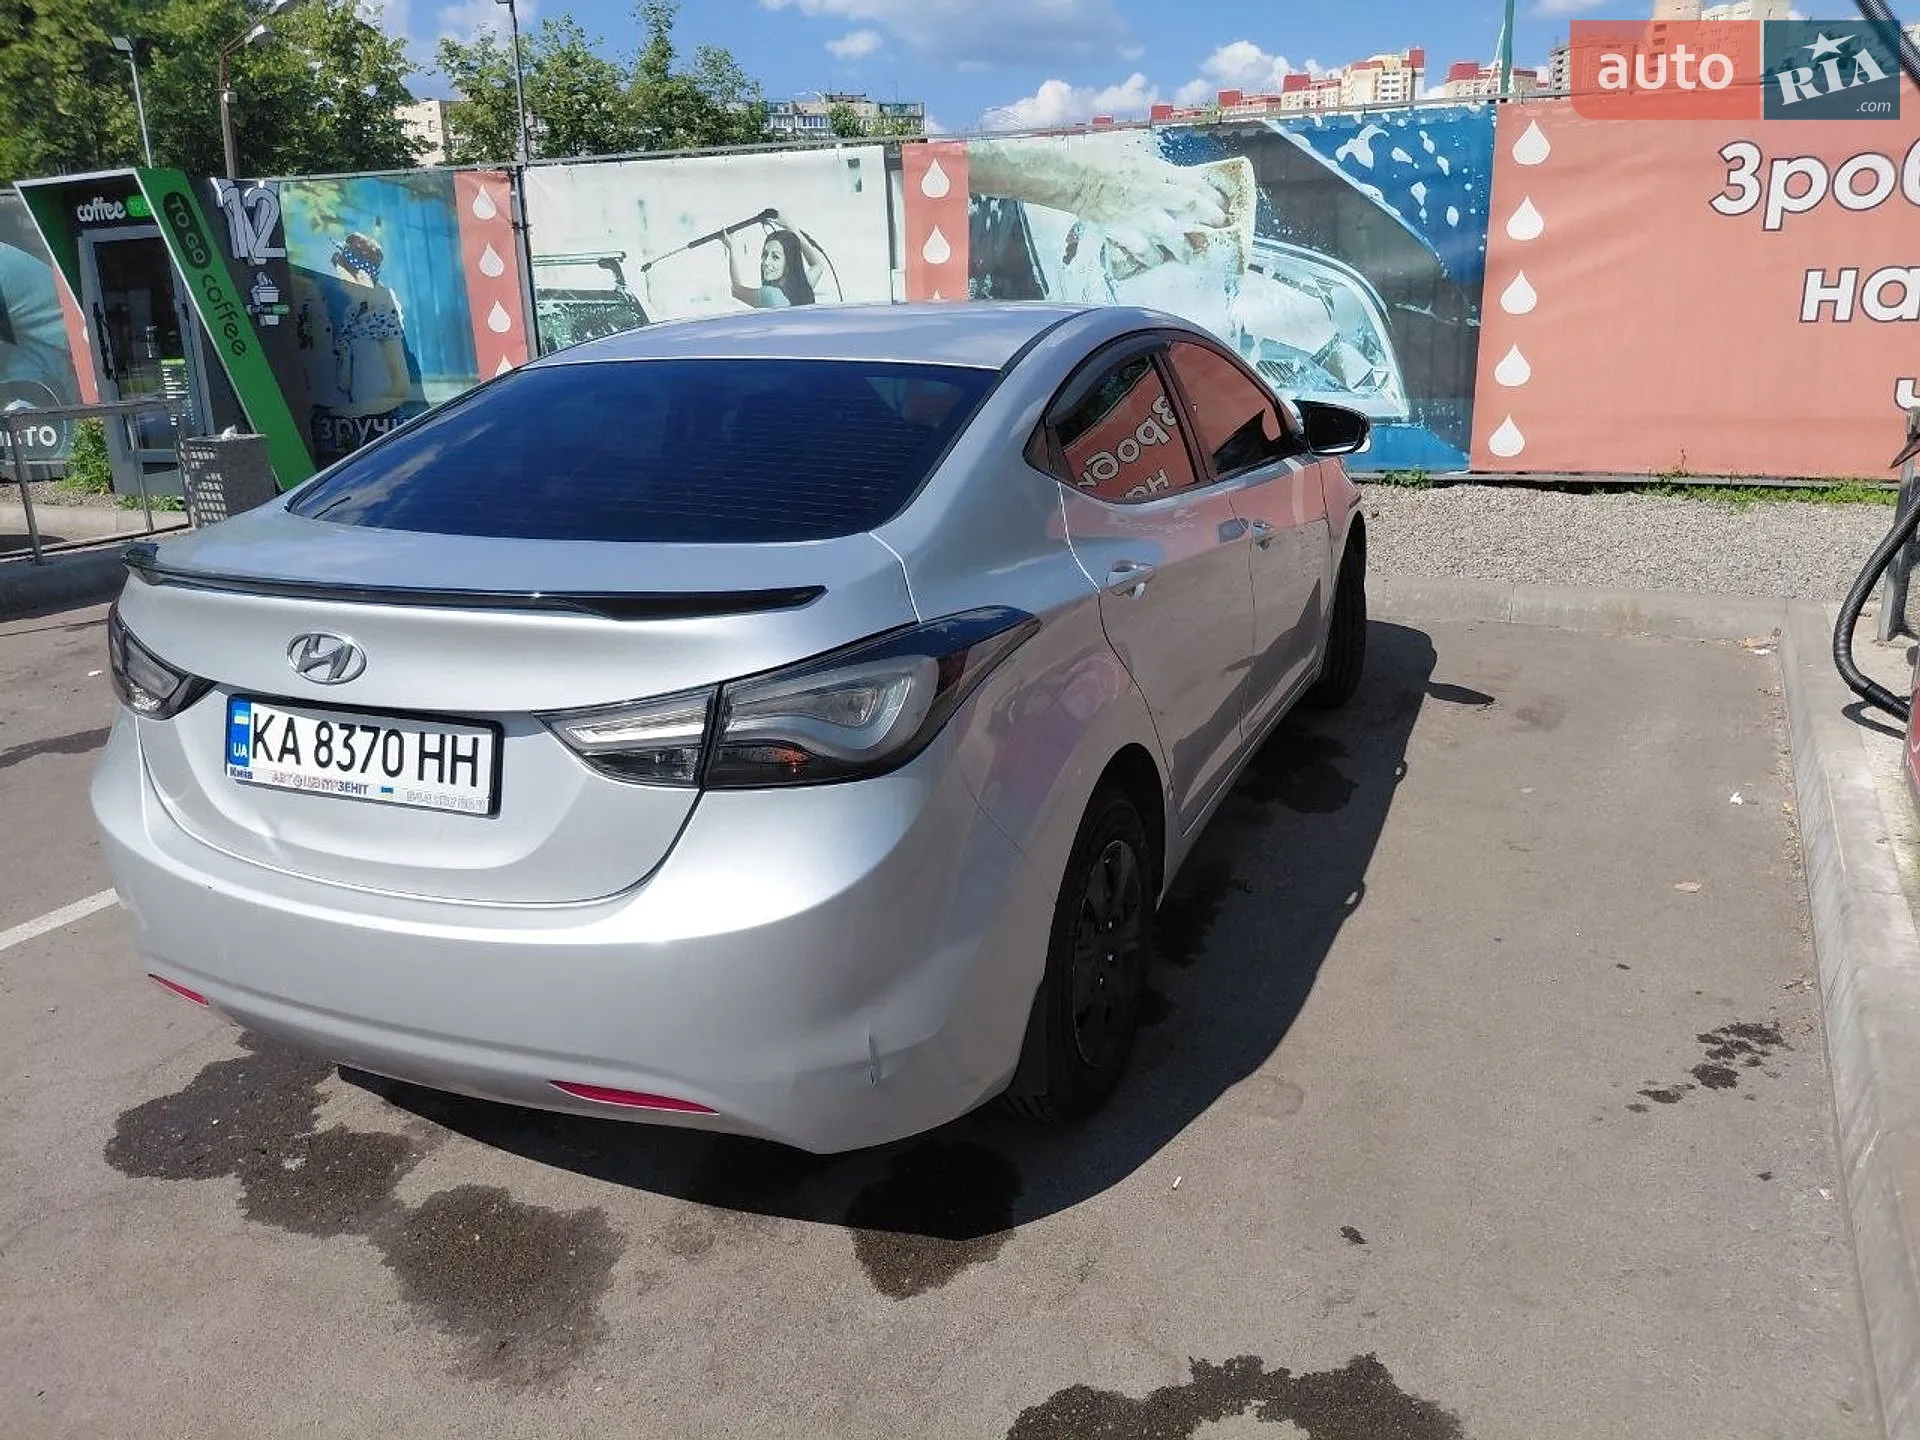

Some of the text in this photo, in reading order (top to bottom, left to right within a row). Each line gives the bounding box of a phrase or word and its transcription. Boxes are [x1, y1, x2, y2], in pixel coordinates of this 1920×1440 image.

[77, 196, 127, 222] coffee
[169, 195, 247, 357] TO GO coffee
[233, 743, 248, 758] UA
[252, 713, 479, 787] KA 8370 HH
